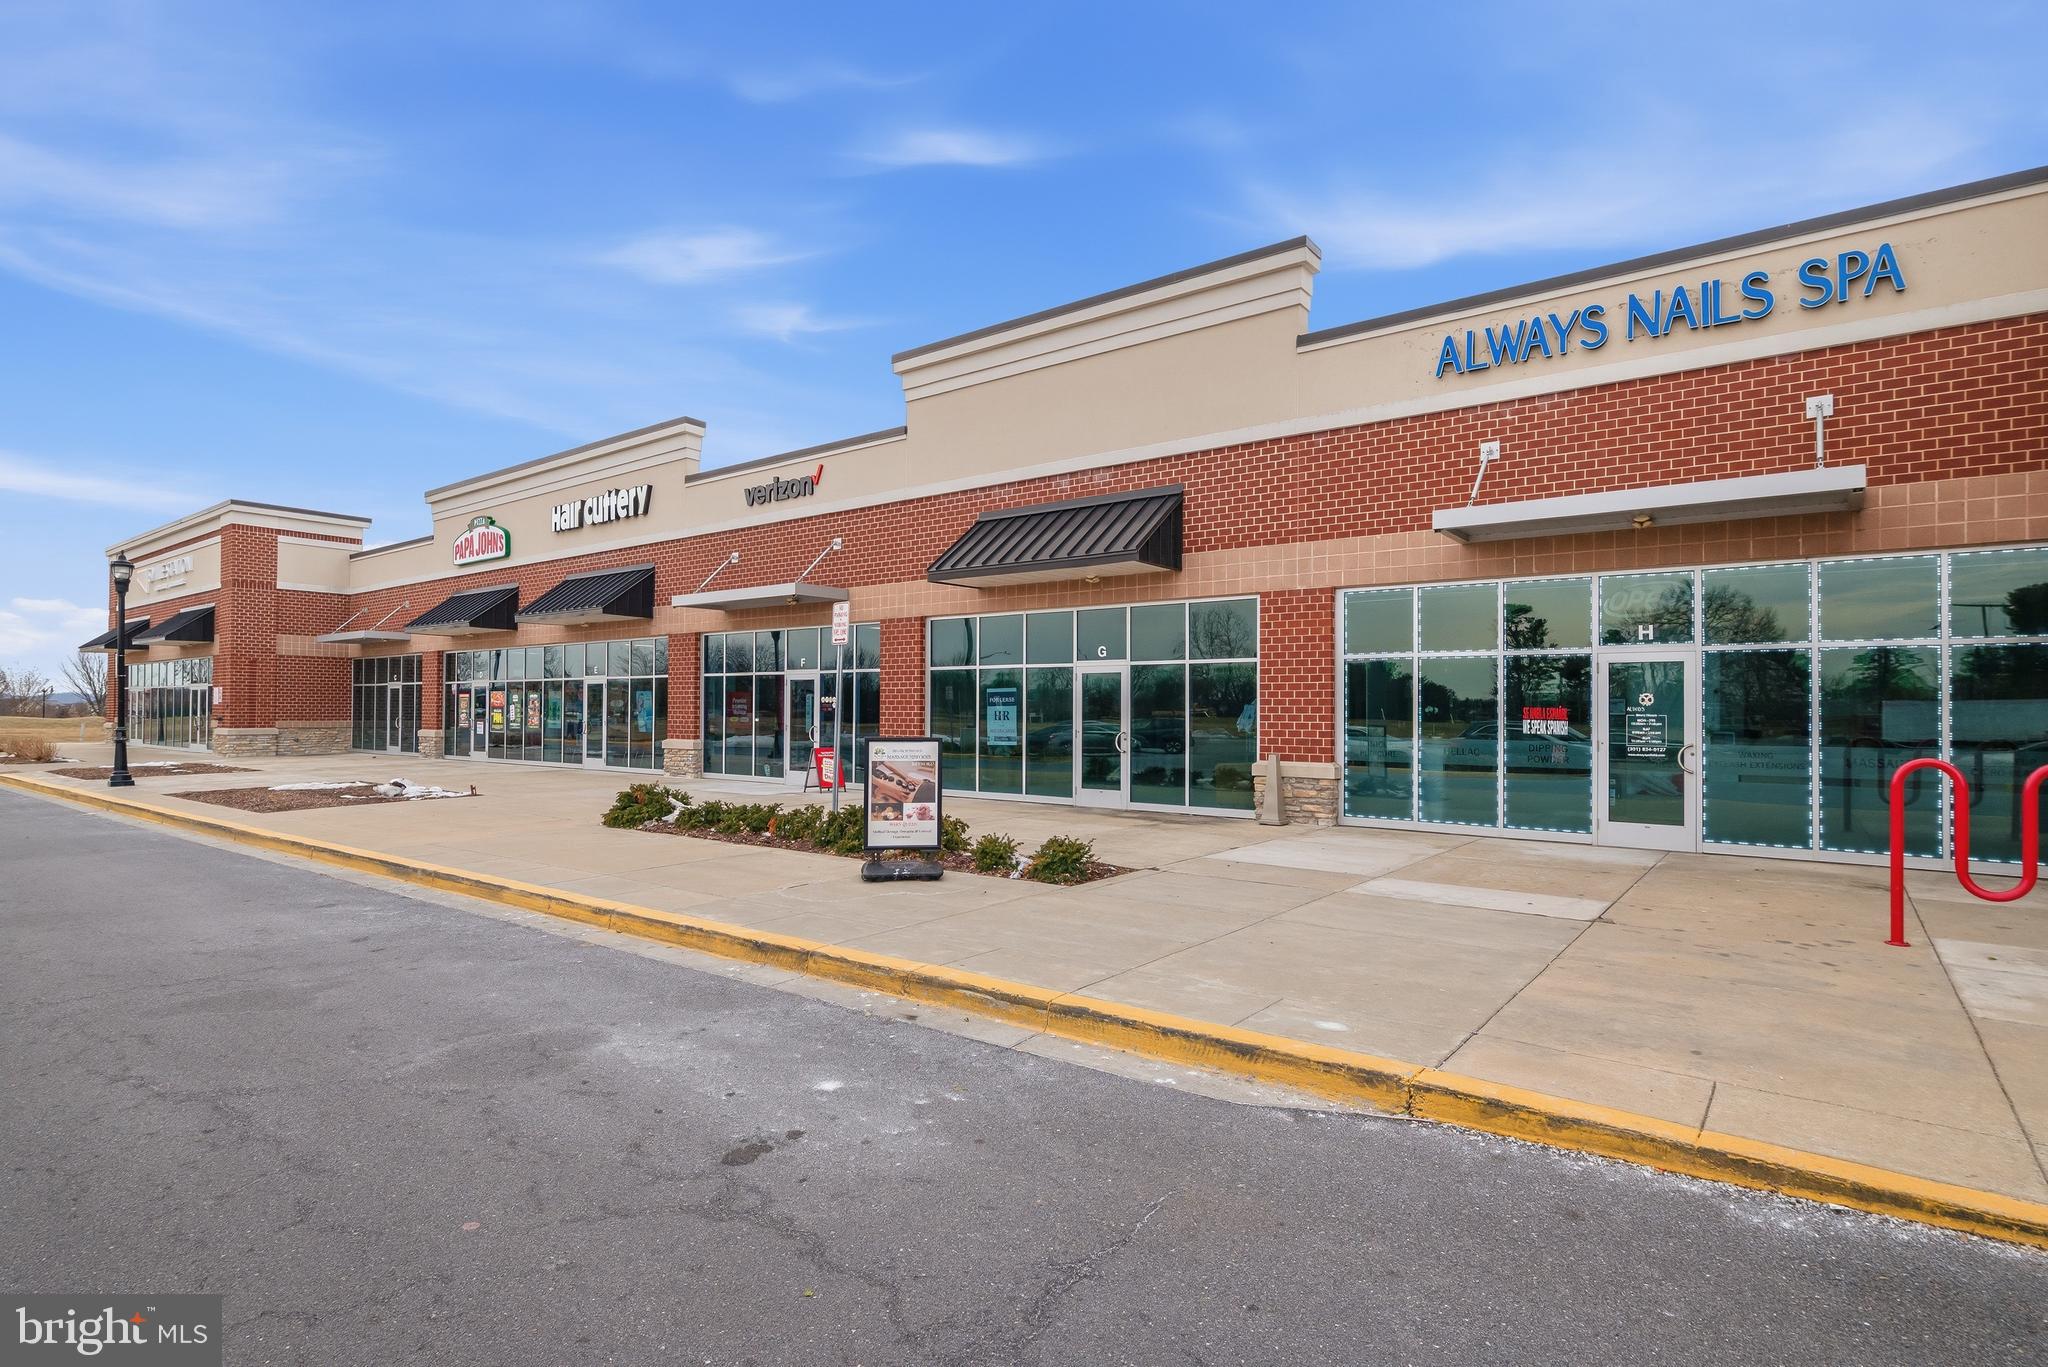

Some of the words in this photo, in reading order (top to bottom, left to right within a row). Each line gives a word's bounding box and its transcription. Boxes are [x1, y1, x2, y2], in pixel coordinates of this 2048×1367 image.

[1435, 304, 1609, 379] ALWAYS
[1625, 270, 1776, 341] NAILS
[1797, 241, 1907, 309] SPA
[744, 476, 814, 507] verizon
[552, 499, 584, 532] Hair
[455, 534, 475, 560] PAPA
[1638, 624, 1654, 641] H
[1097, 645, 1107, 658] G
[800, 657, 806, 668] F
[994, 710, 1010, 721] HR
[1522, 719, 1531, 734] WE
[1530, 719, 1547, 735] SPEAK
[1547, 720, 1569, 736] SPANISH
[1528, 744, 1569, 753] DIPPING
[1527, 755, 1569, 764] POWDER
[1738, 751, 1776, 759] WAXING
[1749, 761, 1808, 770] EXTENSIONS
[1845, 757, 1903, 769] MASSA
